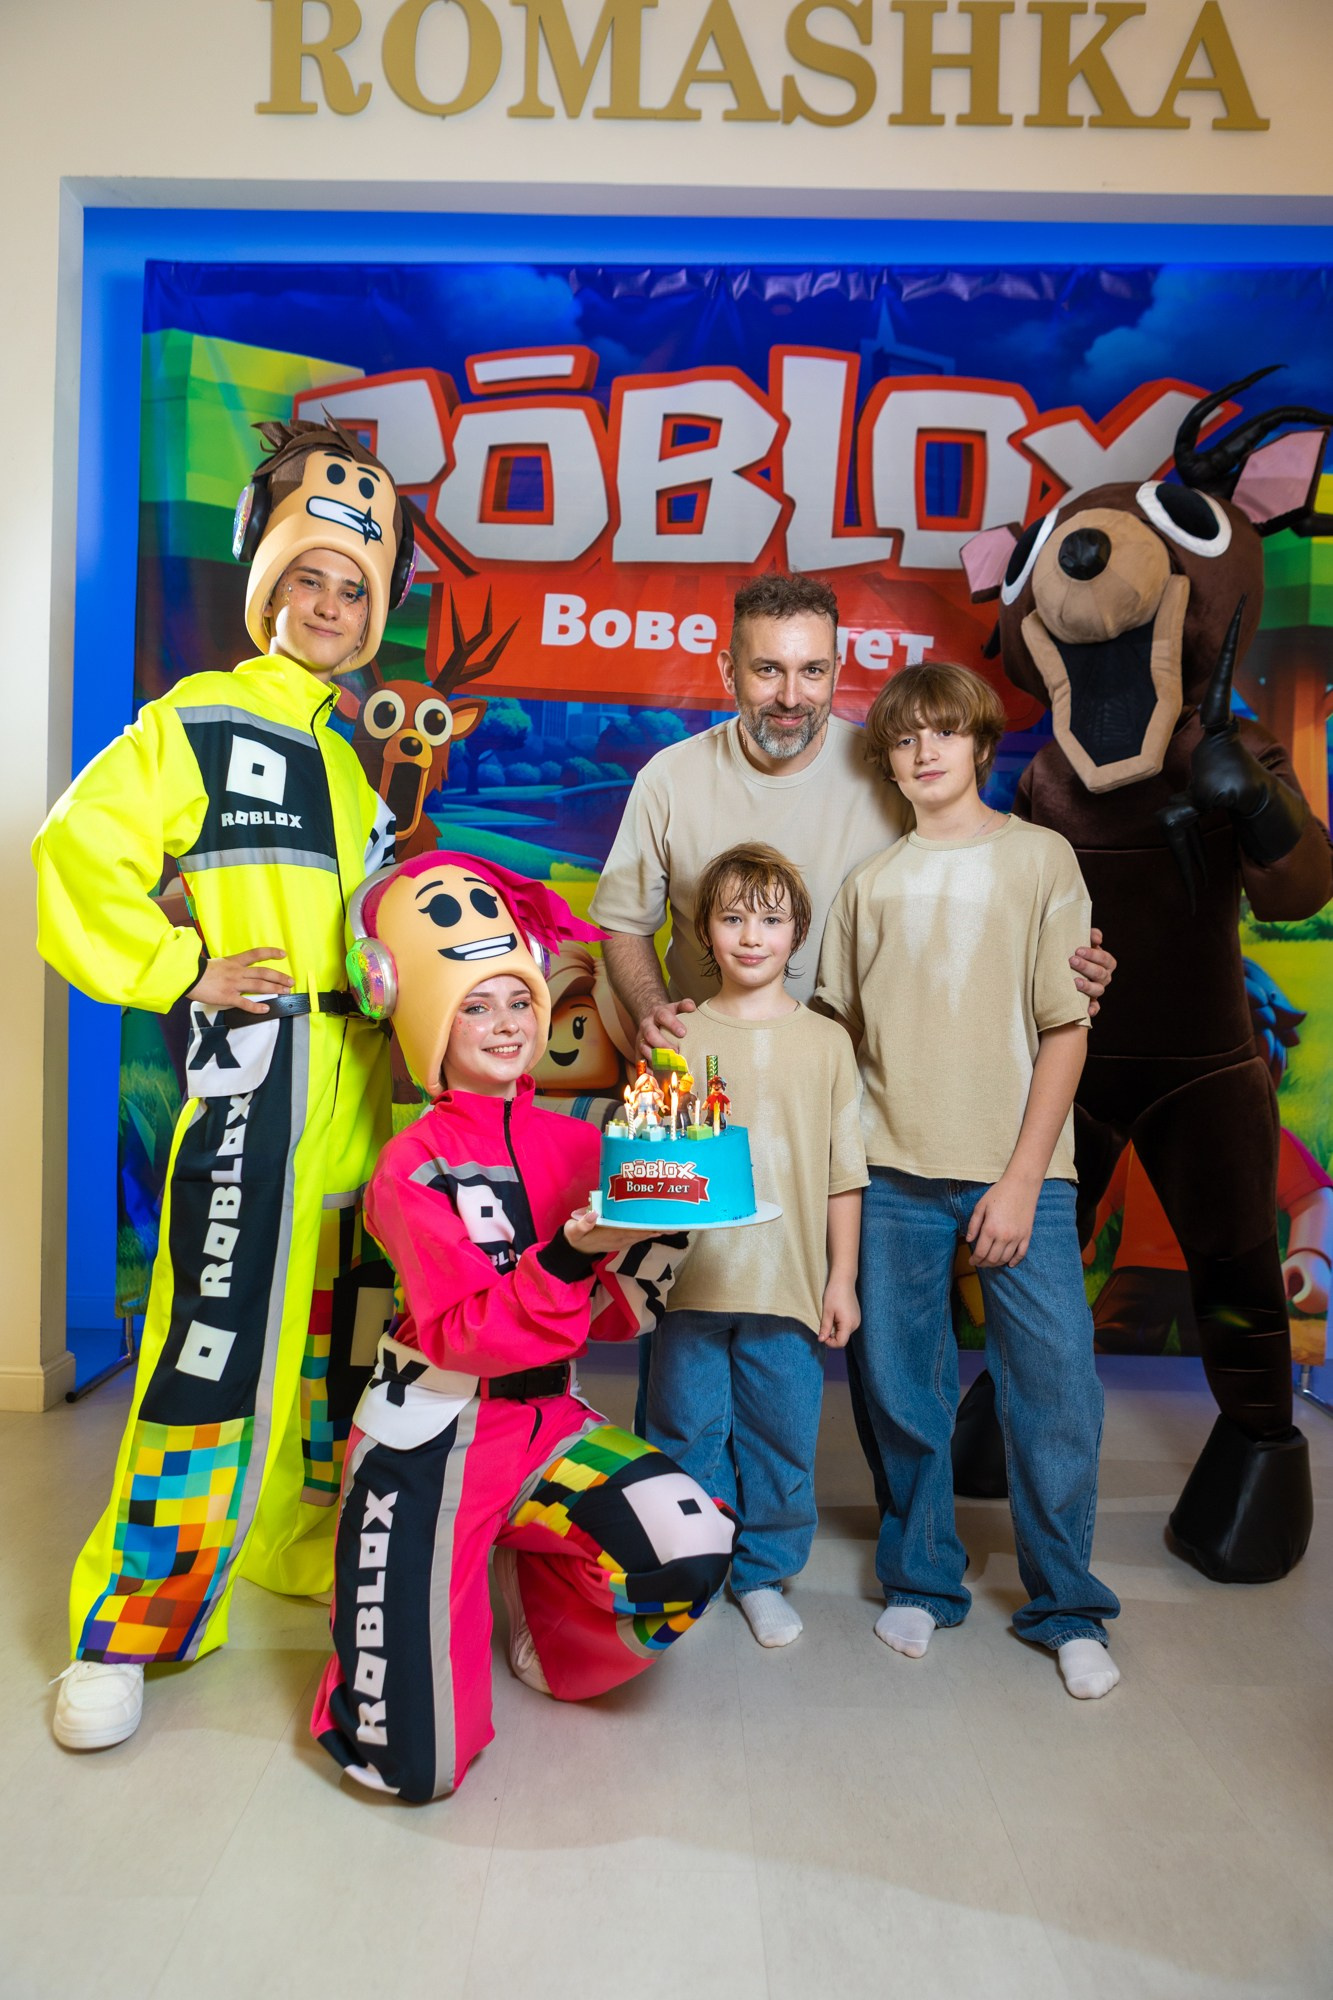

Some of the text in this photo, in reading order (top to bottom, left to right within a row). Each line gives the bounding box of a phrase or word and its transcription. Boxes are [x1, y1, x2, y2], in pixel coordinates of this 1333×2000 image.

[254, 0, 1270, 131] ROMASHKA
[541, 593, 717, 654] Вове
[221, 811, 303, 830] ROBLOX
[200, 1091, 254, 1298] ROBLOX
[626, 1180, 690, 1193] Вове 7 лет
[353, 1490, 399, 1746] ROBLOX
